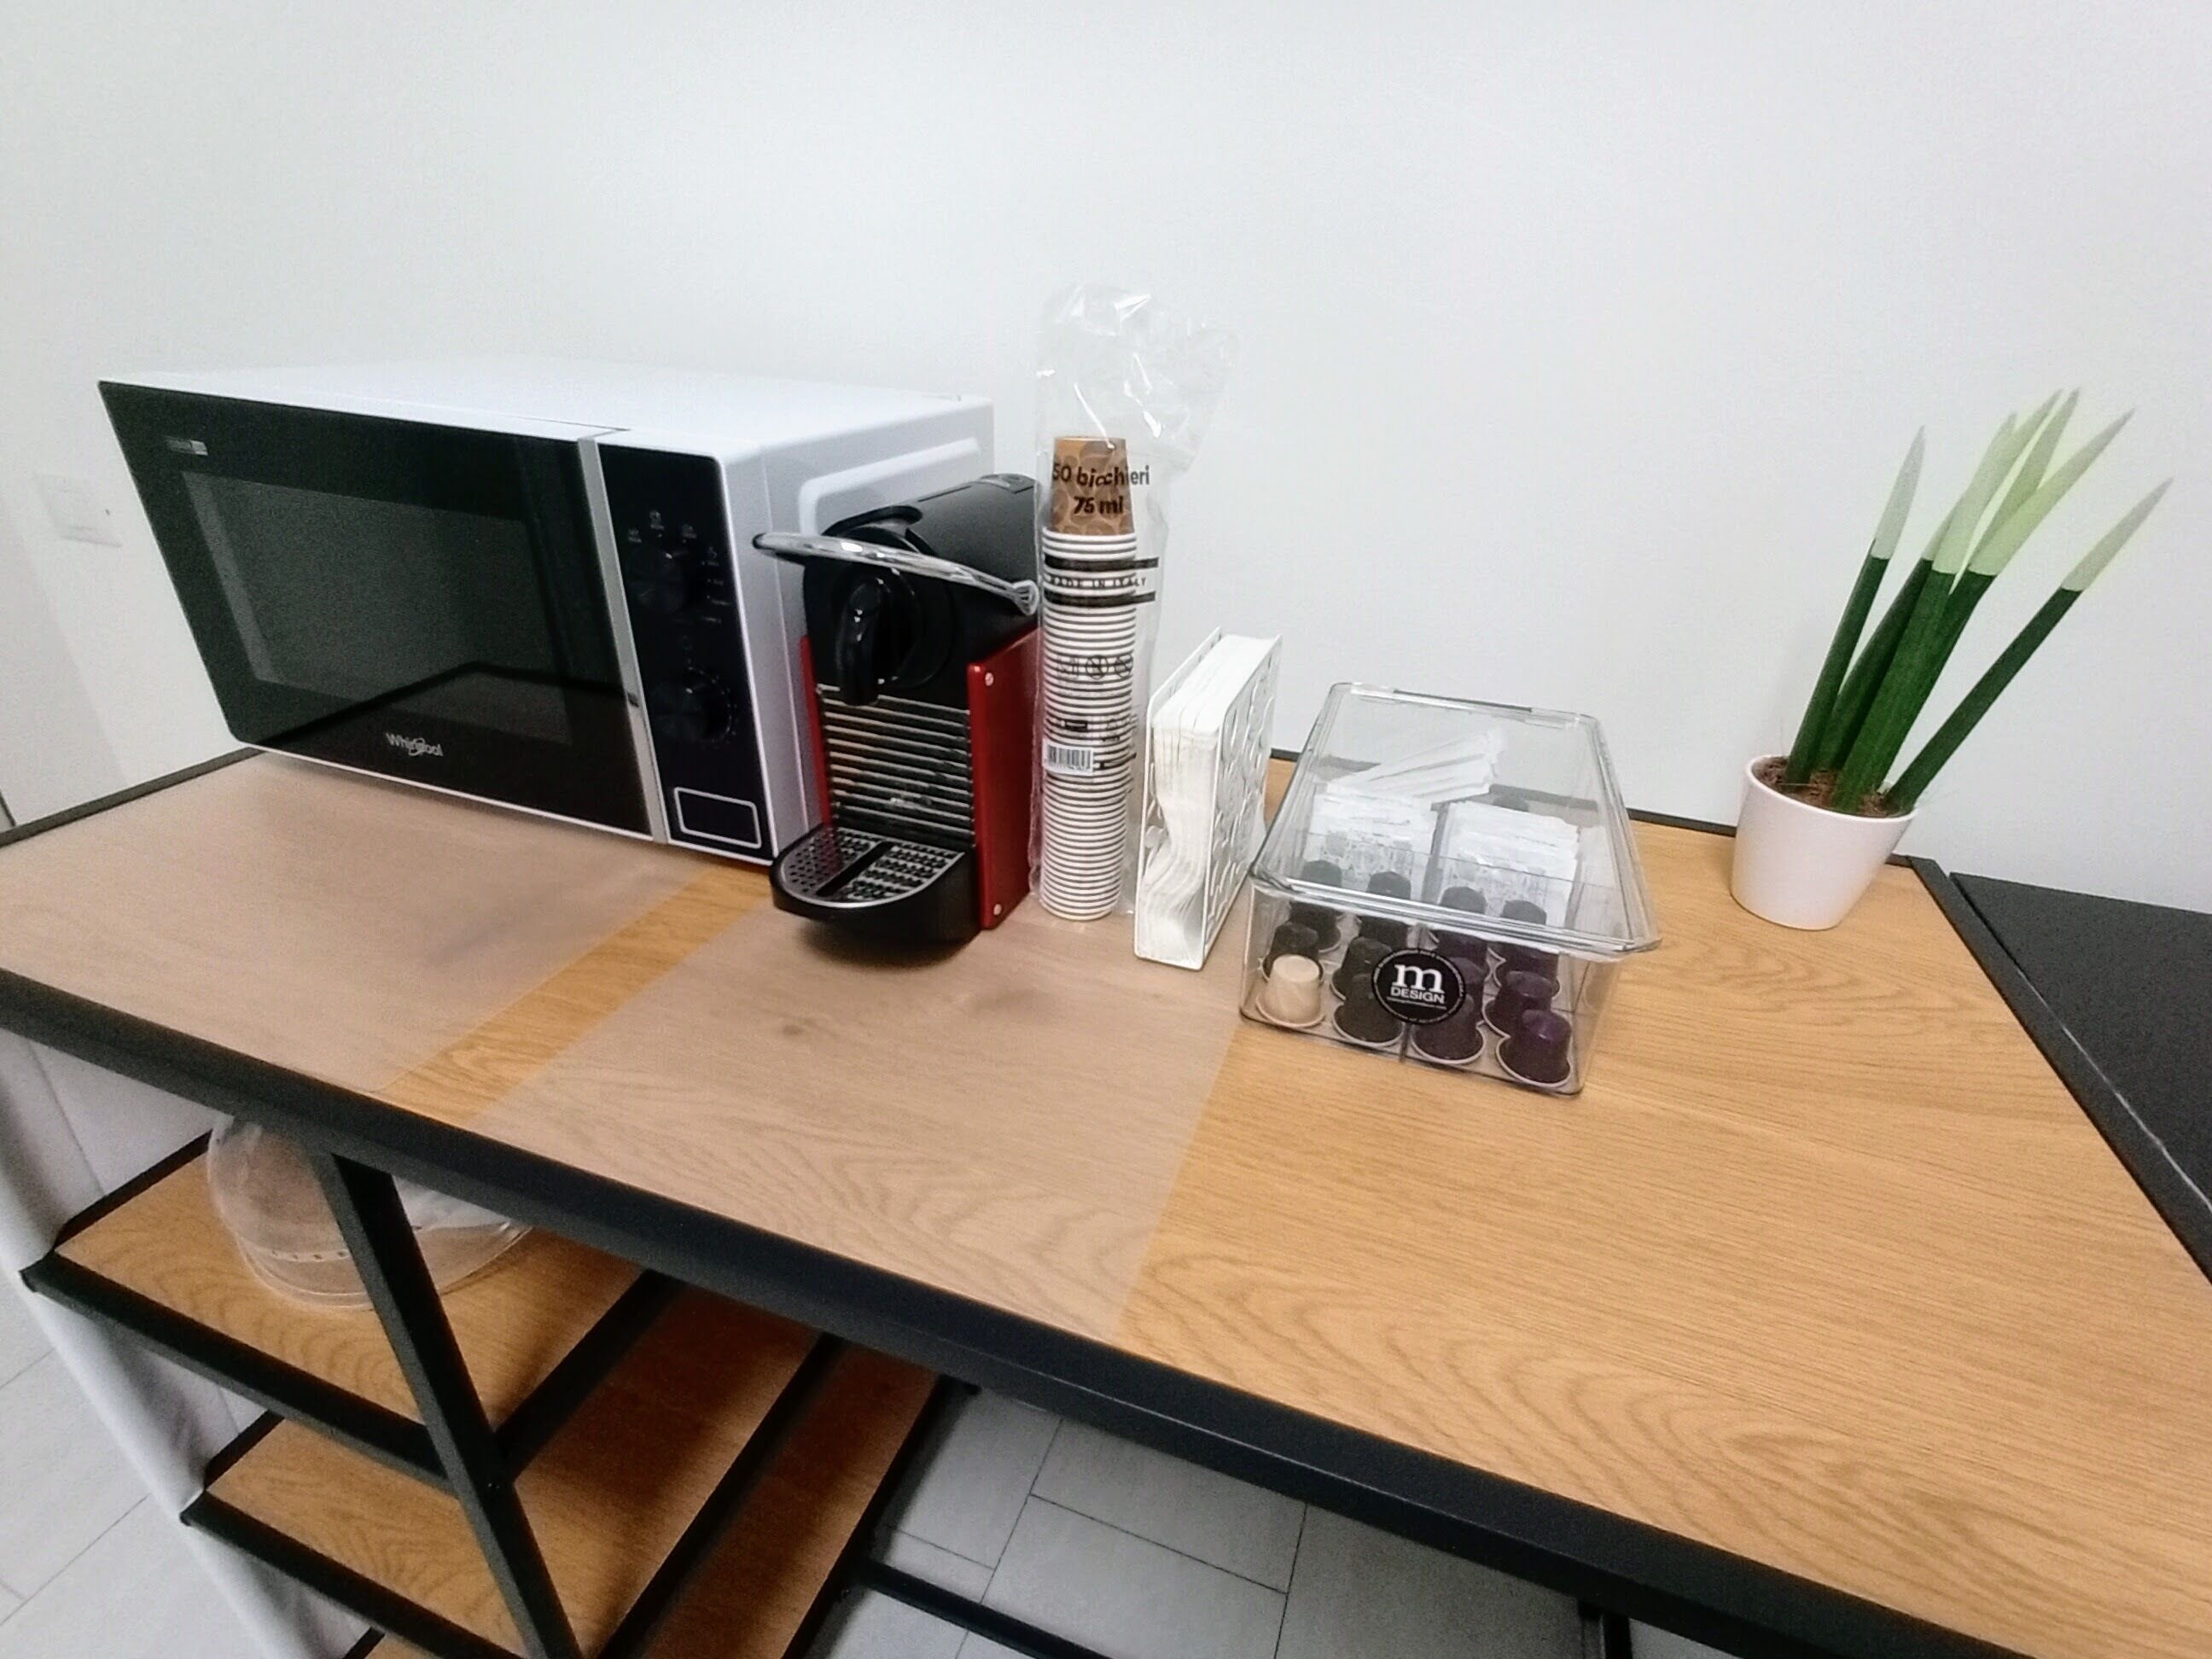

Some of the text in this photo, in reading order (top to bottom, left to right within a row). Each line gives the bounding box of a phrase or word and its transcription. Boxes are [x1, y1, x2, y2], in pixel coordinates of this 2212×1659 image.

[1052, 463, 1071, 482] 50
[1074, 495, 1124, 515] 75 ml
[385, 732, 444, 757] Whirlpool
[1390, 987, 1446, 1004] DESIGN
